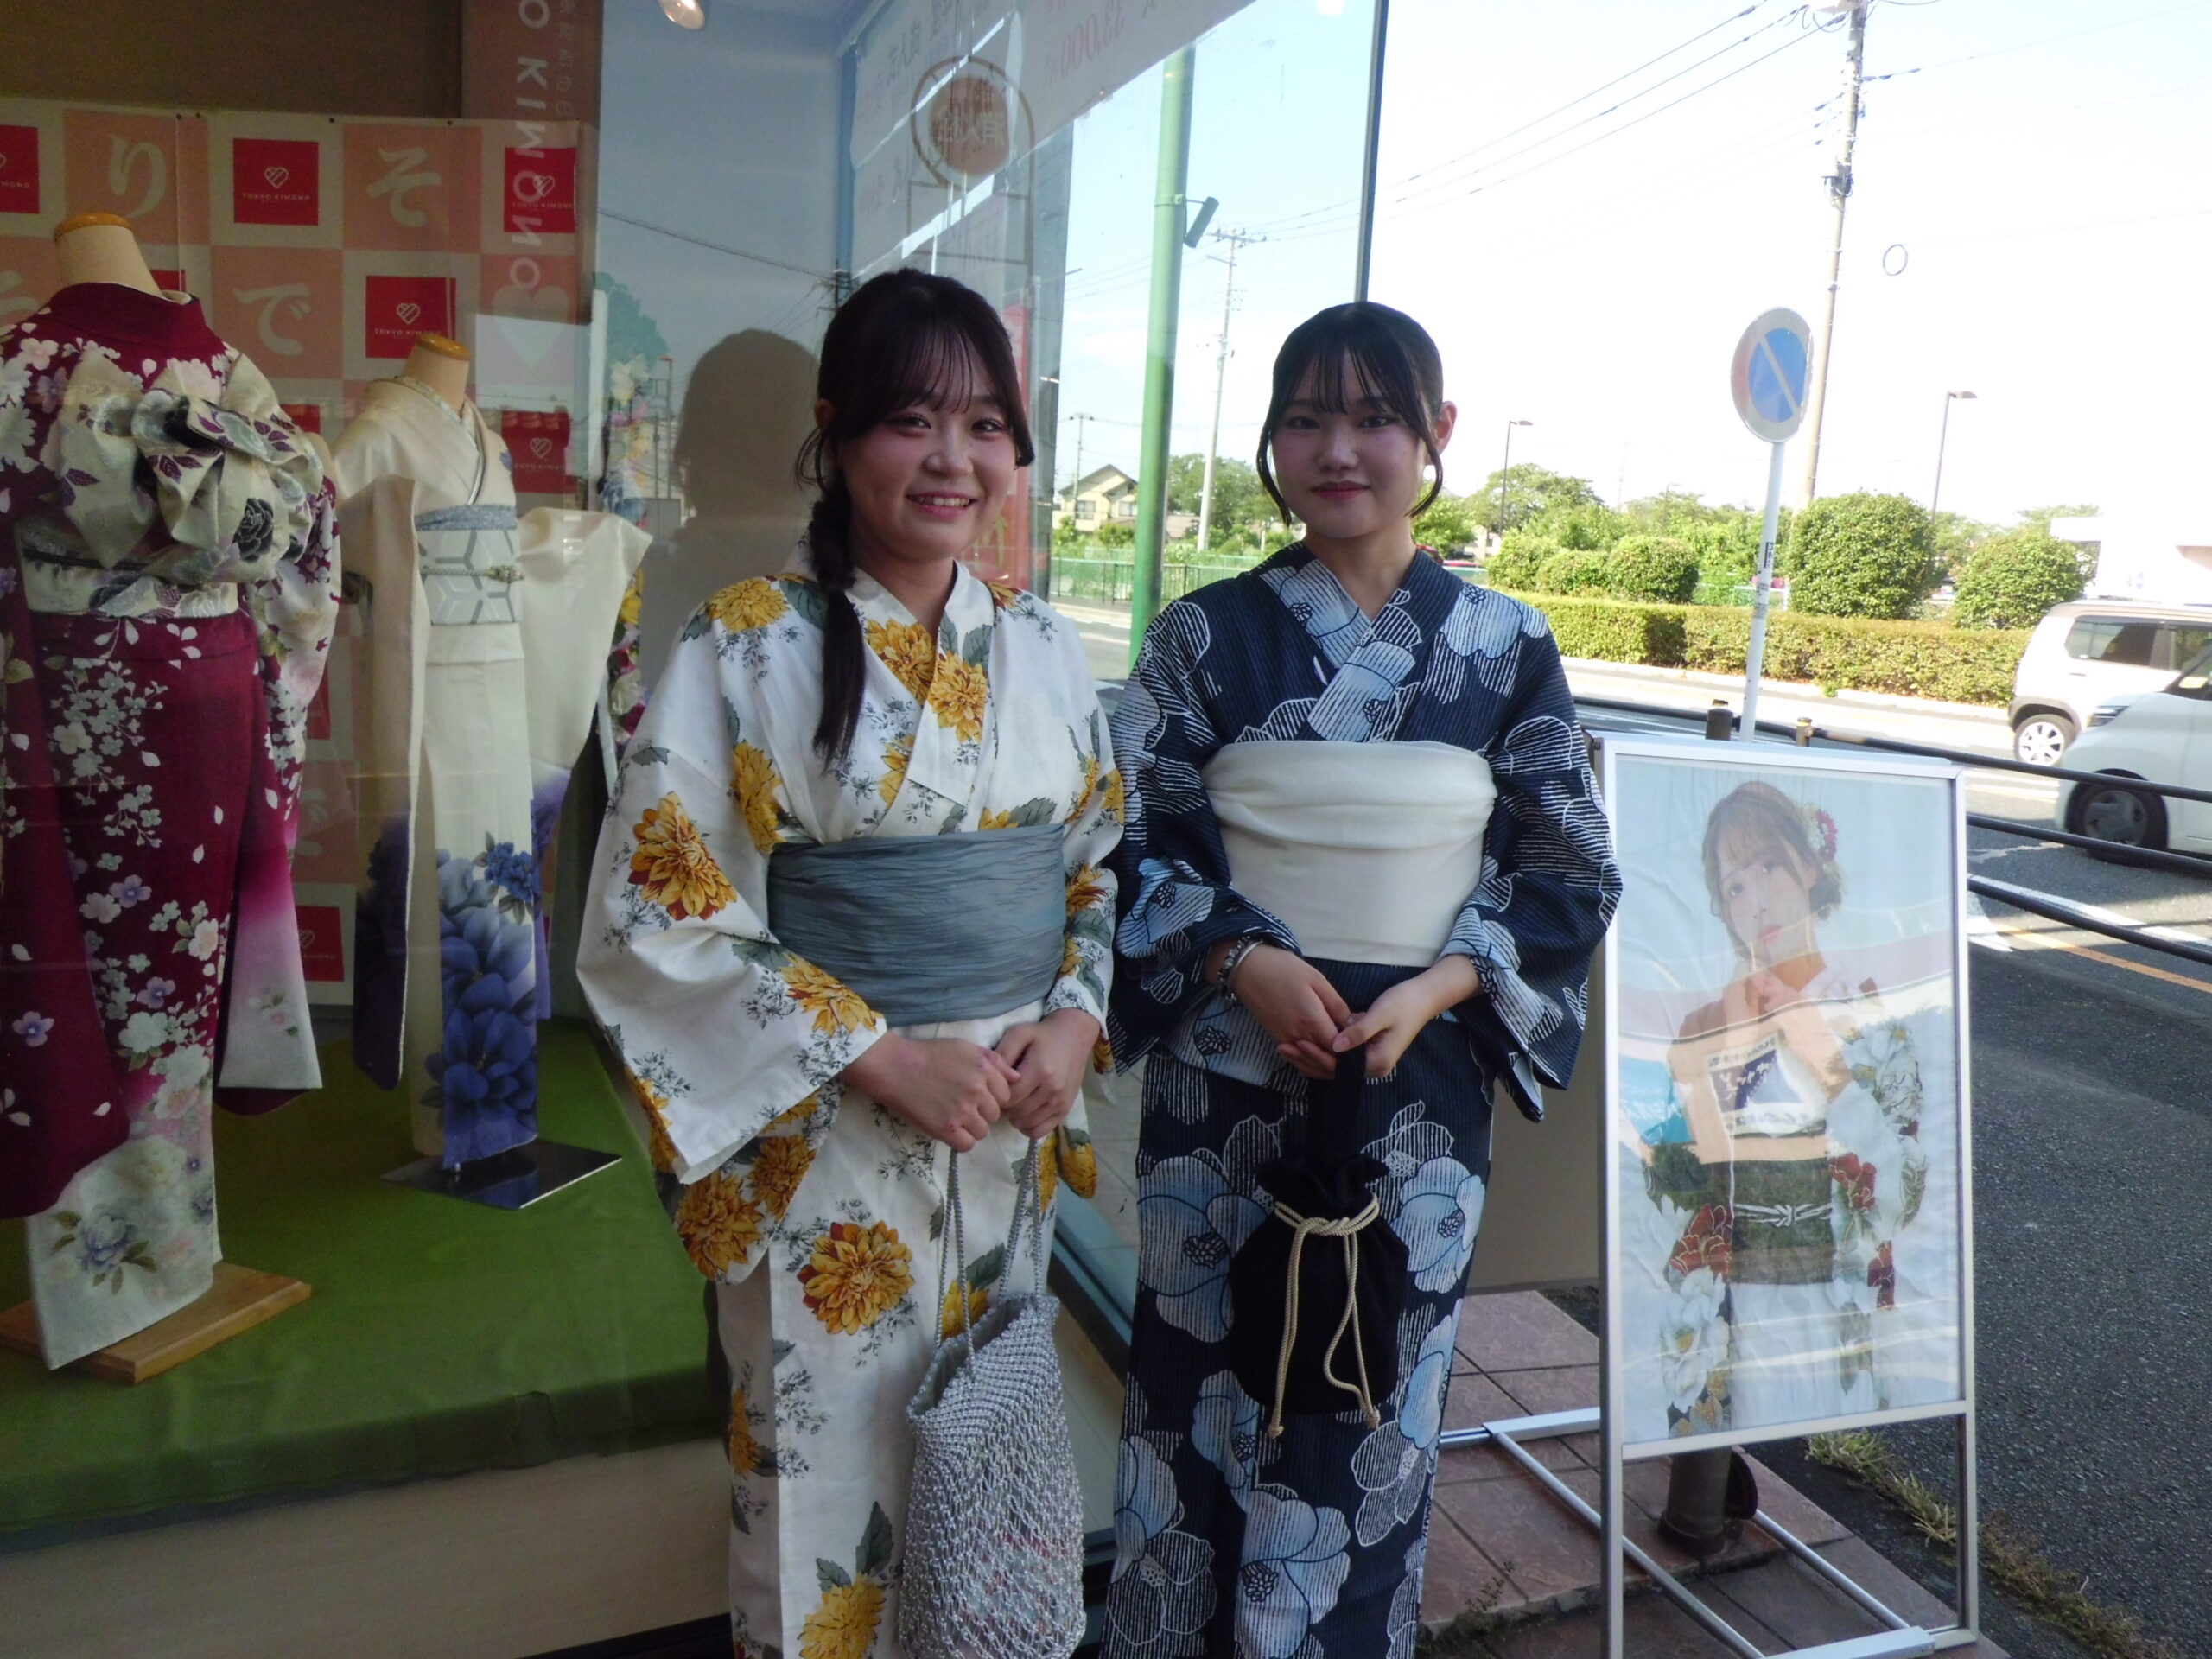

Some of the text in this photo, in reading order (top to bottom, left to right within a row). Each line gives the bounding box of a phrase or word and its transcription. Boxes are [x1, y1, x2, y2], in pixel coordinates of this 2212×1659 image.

[111, 136, 166, 218] り
[367, 147, 442, 227] そ
[232, 283, 311, 356] で
